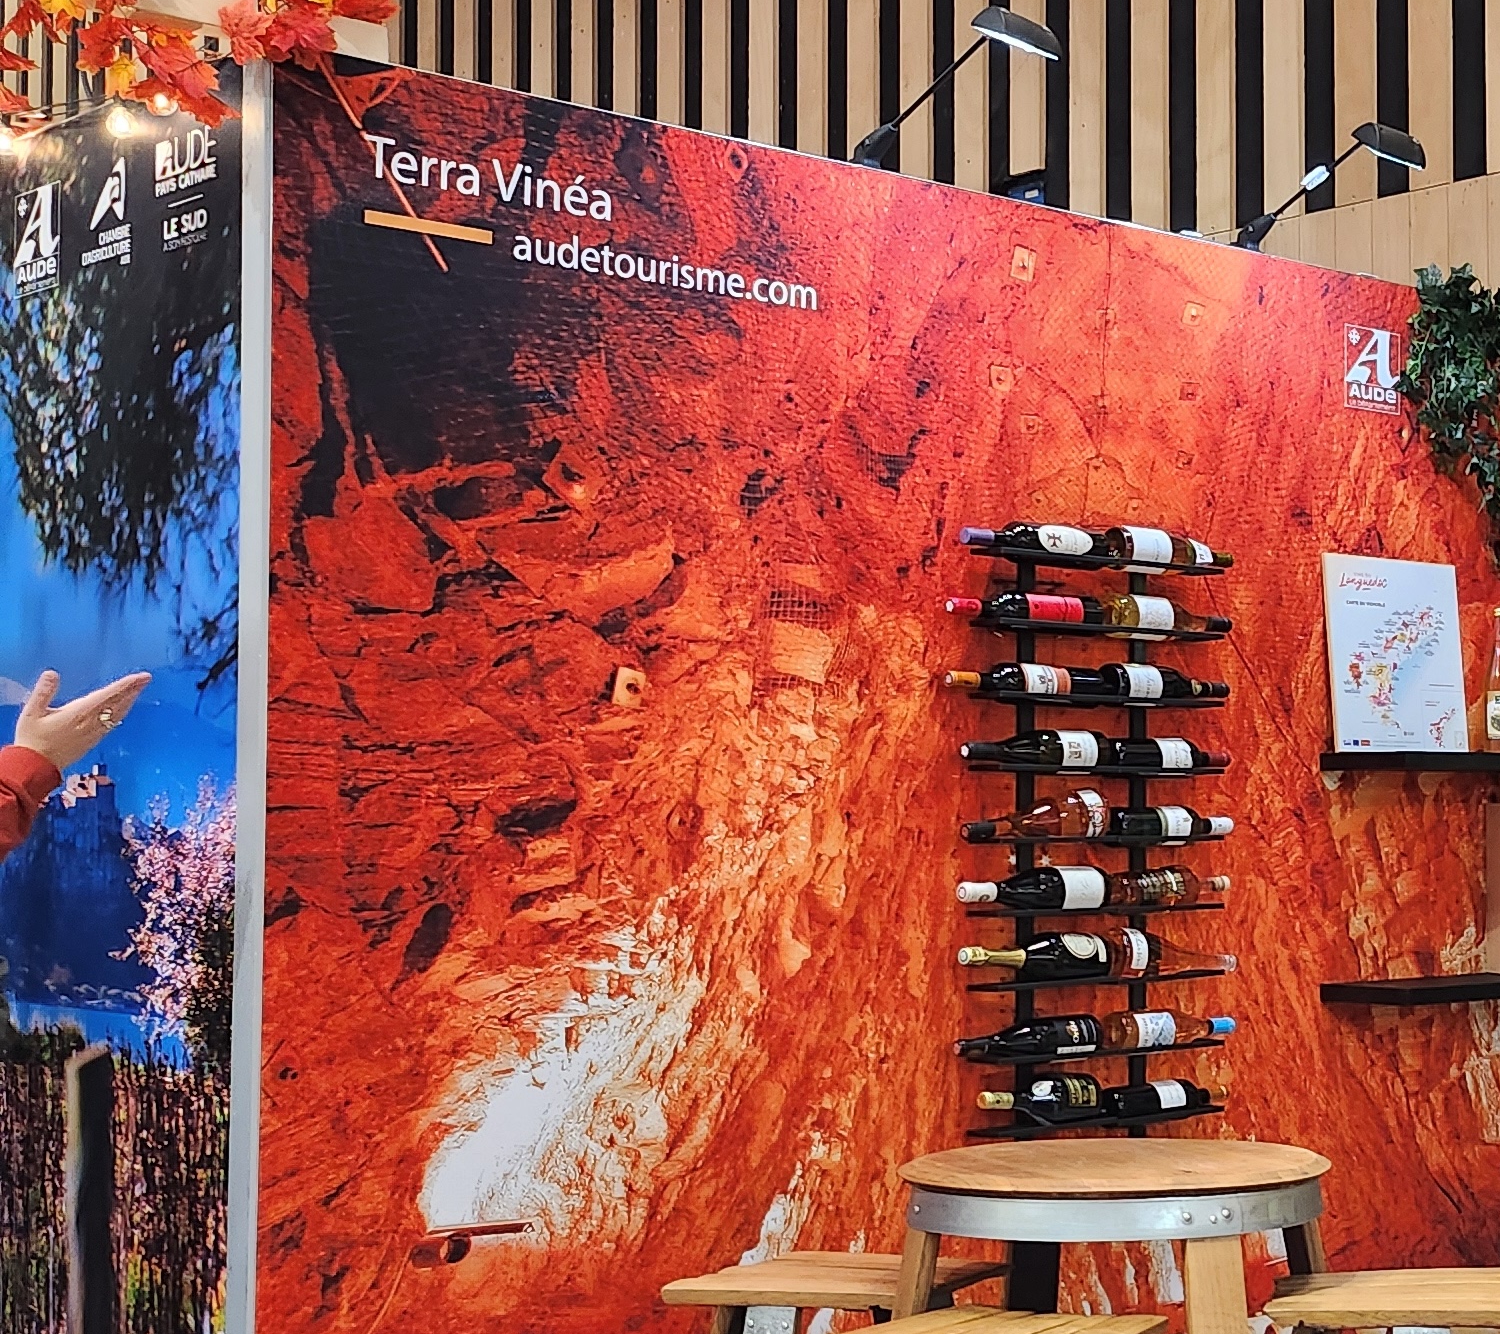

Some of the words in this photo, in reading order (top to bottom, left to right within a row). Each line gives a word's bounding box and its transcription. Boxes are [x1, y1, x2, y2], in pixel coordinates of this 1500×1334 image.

[364, 133, 481, 197] Terra
[493, 158, 613, 222] Vinéa
[163, 218, 179, 240] LE
[180, 208, 208, 234] SUD
[512, 233, 818, 311] audetourisme.com
